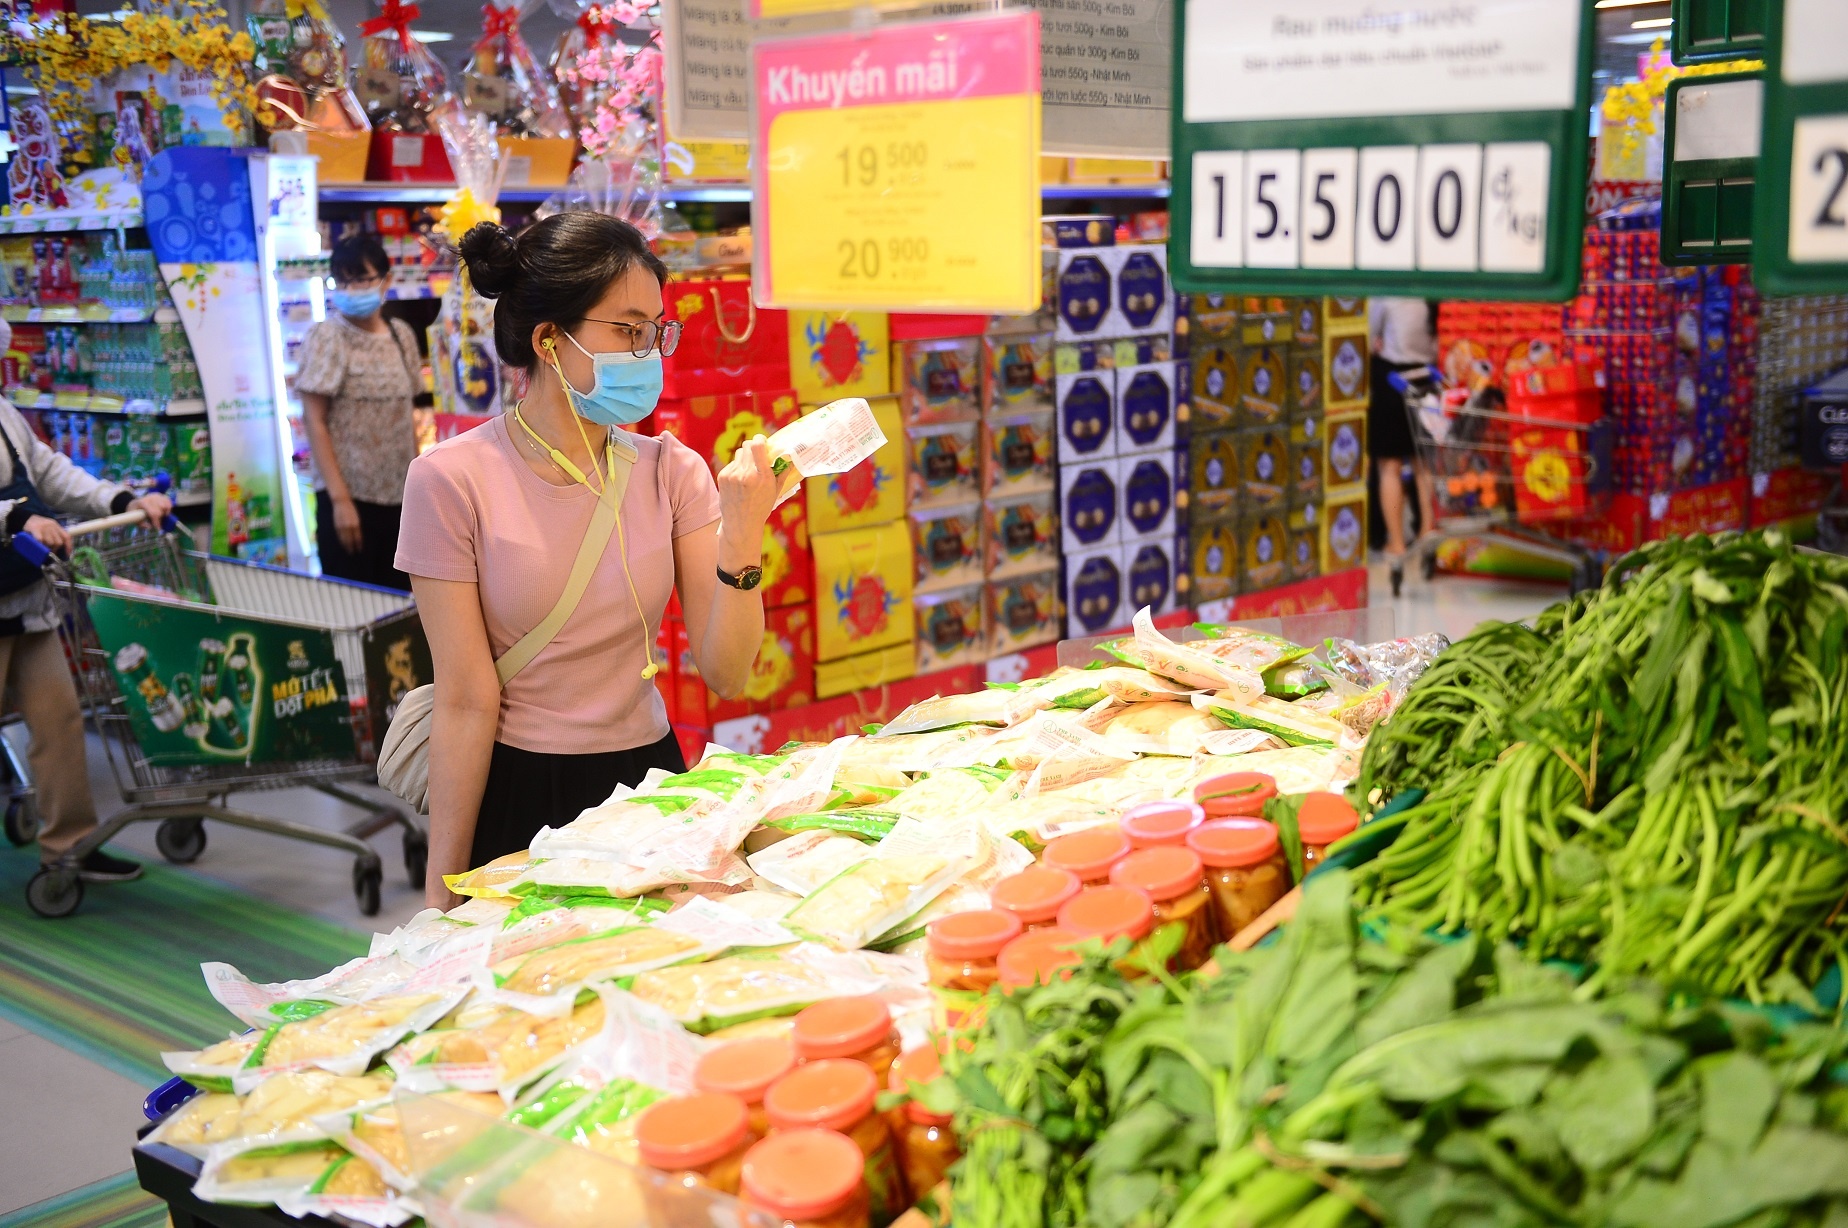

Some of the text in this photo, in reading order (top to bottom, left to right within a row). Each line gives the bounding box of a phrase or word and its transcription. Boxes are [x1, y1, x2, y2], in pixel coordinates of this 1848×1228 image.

[1074, 22, 1094, 38] 500g
[1100, 23, 1115, 36] Kim
[1117, 25, 1129, 38] Bôi
[1088, 46, 1107, 60] 300g
[1128, 48, 1140, 61] Bôi
[769, 50, 959, 107] Khuyến mãi
[1068, 67, 1088, 83] 550g
[1113, 69, 1131, 82] Minh
[1088, 91, 1108, 106] 550g
[1134, 93, 1152, 105] Minh
[1211, 170, 1463, 242] 15.500
[838, 237, 881, 280] 20
